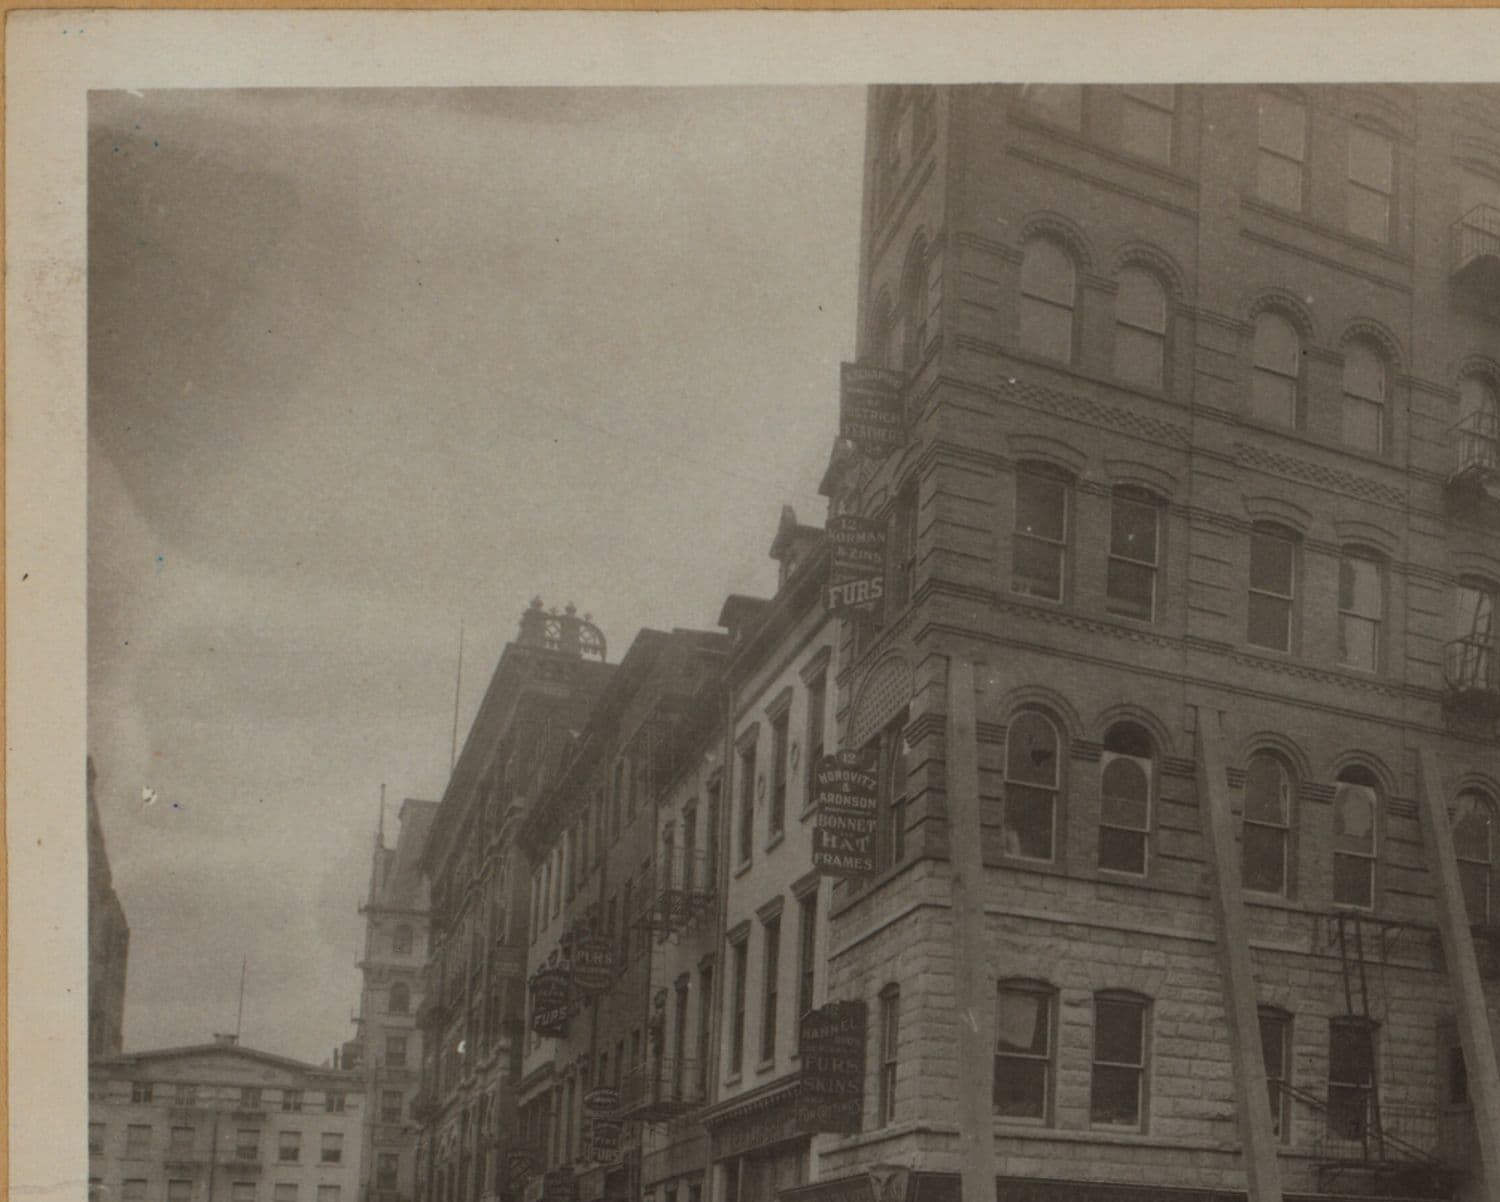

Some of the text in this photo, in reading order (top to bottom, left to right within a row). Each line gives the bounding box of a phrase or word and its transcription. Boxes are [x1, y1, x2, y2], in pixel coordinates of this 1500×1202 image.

[829, 576, 884, 609] FURS
[842, 752, 857, 765] 12
[819, 791, 877, 809] ARONSON
[817, 813, 877, 833] BONNET
[821, 830, 870, 853] HAT
[814, 852, 873, 871] FRAMES
[535, 1005, 568, 1029] FURS
[805, 1057, 859, 1073] FURS
[803, 1078, 860, 1094] SKINS
